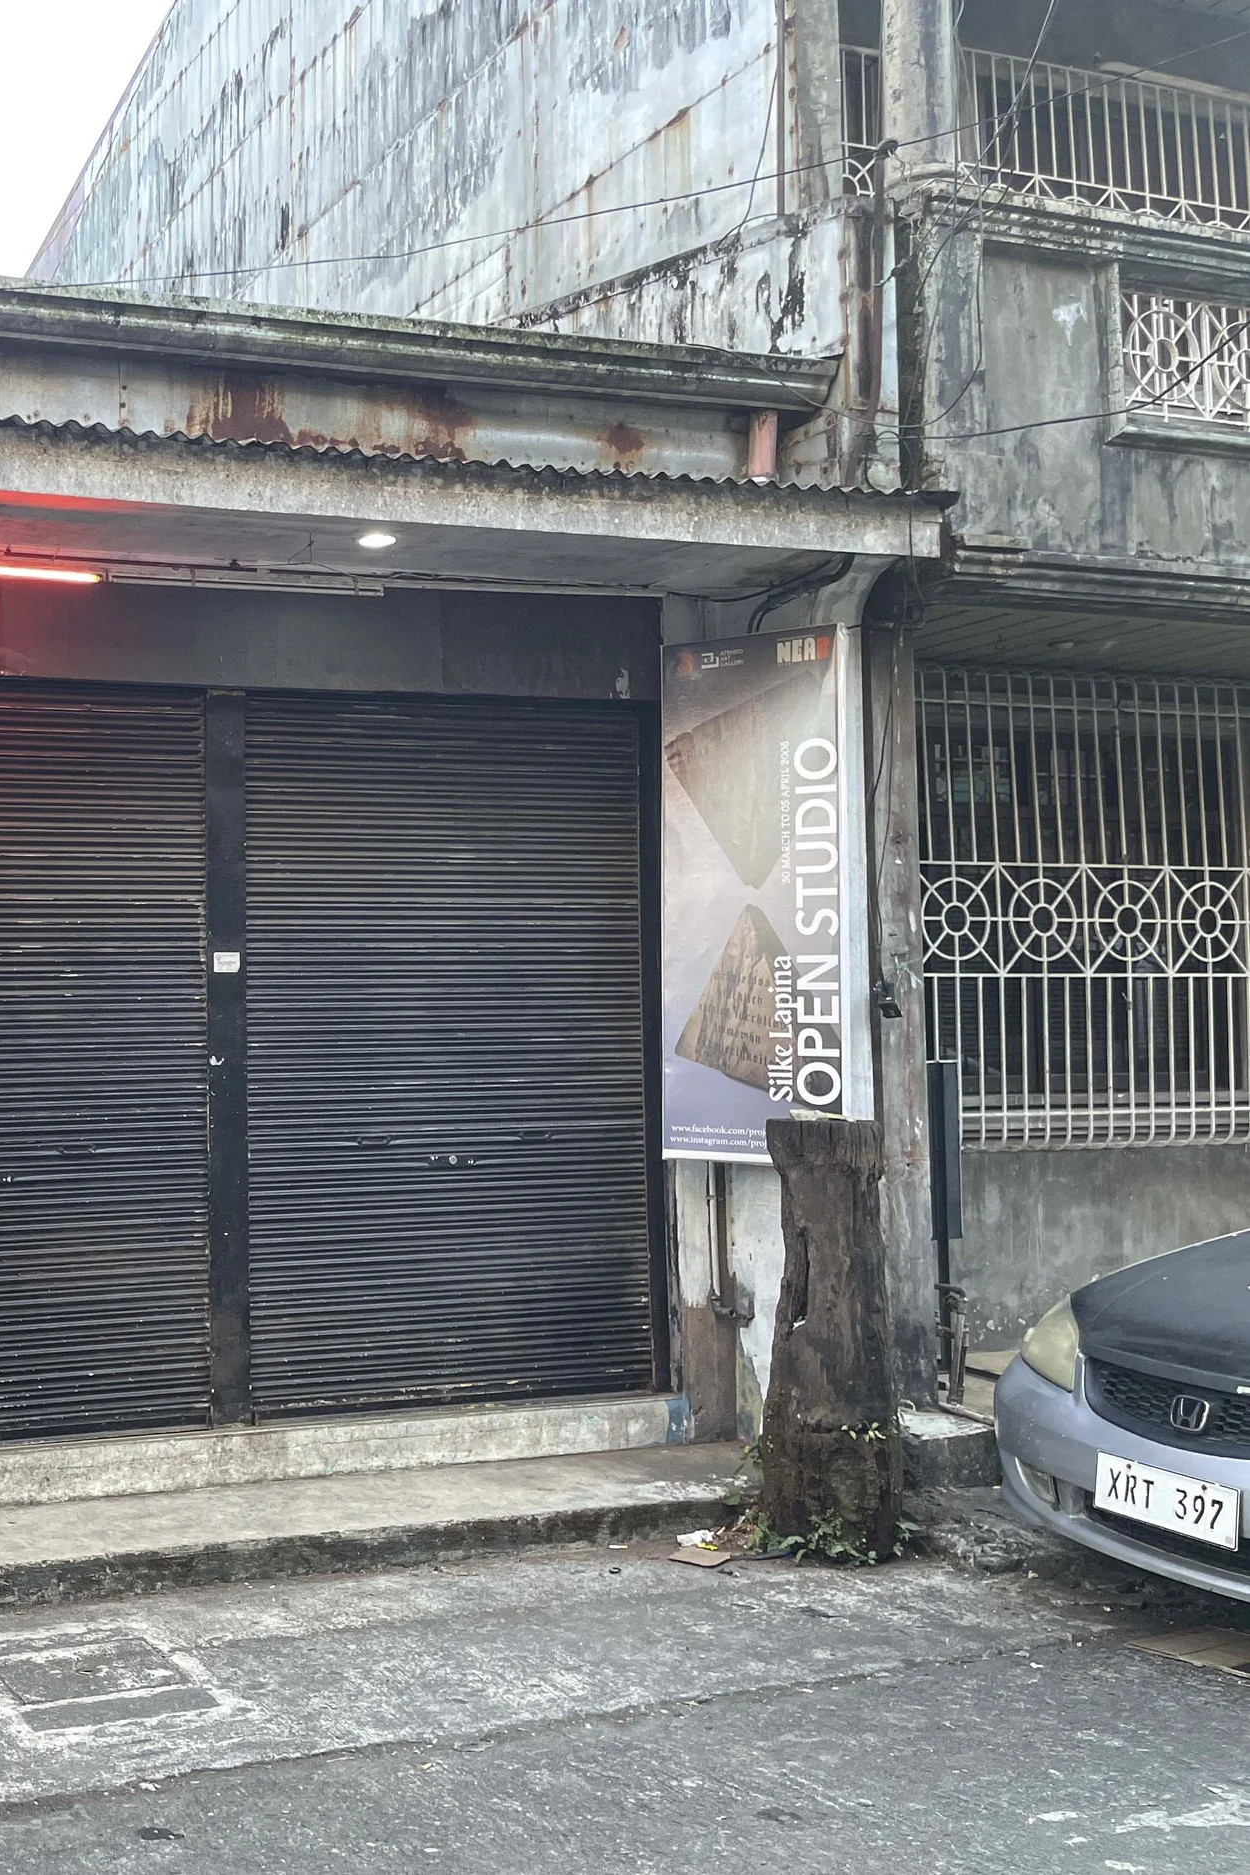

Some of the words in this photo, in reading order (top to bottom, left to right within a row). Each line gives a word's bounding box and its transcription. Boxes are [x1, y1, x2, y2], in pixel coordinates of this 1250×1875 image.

[780, 767, 790, 797] APRIL
[781, 813, 790, 828] TO
[781, 831, 791, 868] MARCH
[793, 737, 839, 937] STUDIO
[781, 870, 791, 884] 30
[767, 954, 798, 1039] Lapina
[796, 953, 841, 1106] OPEN
[767, 1043, 793, 1103] Silke
[1107, 1467, 1155, 1509] XRT
[1174, 1488, 1224, 1530] 397
